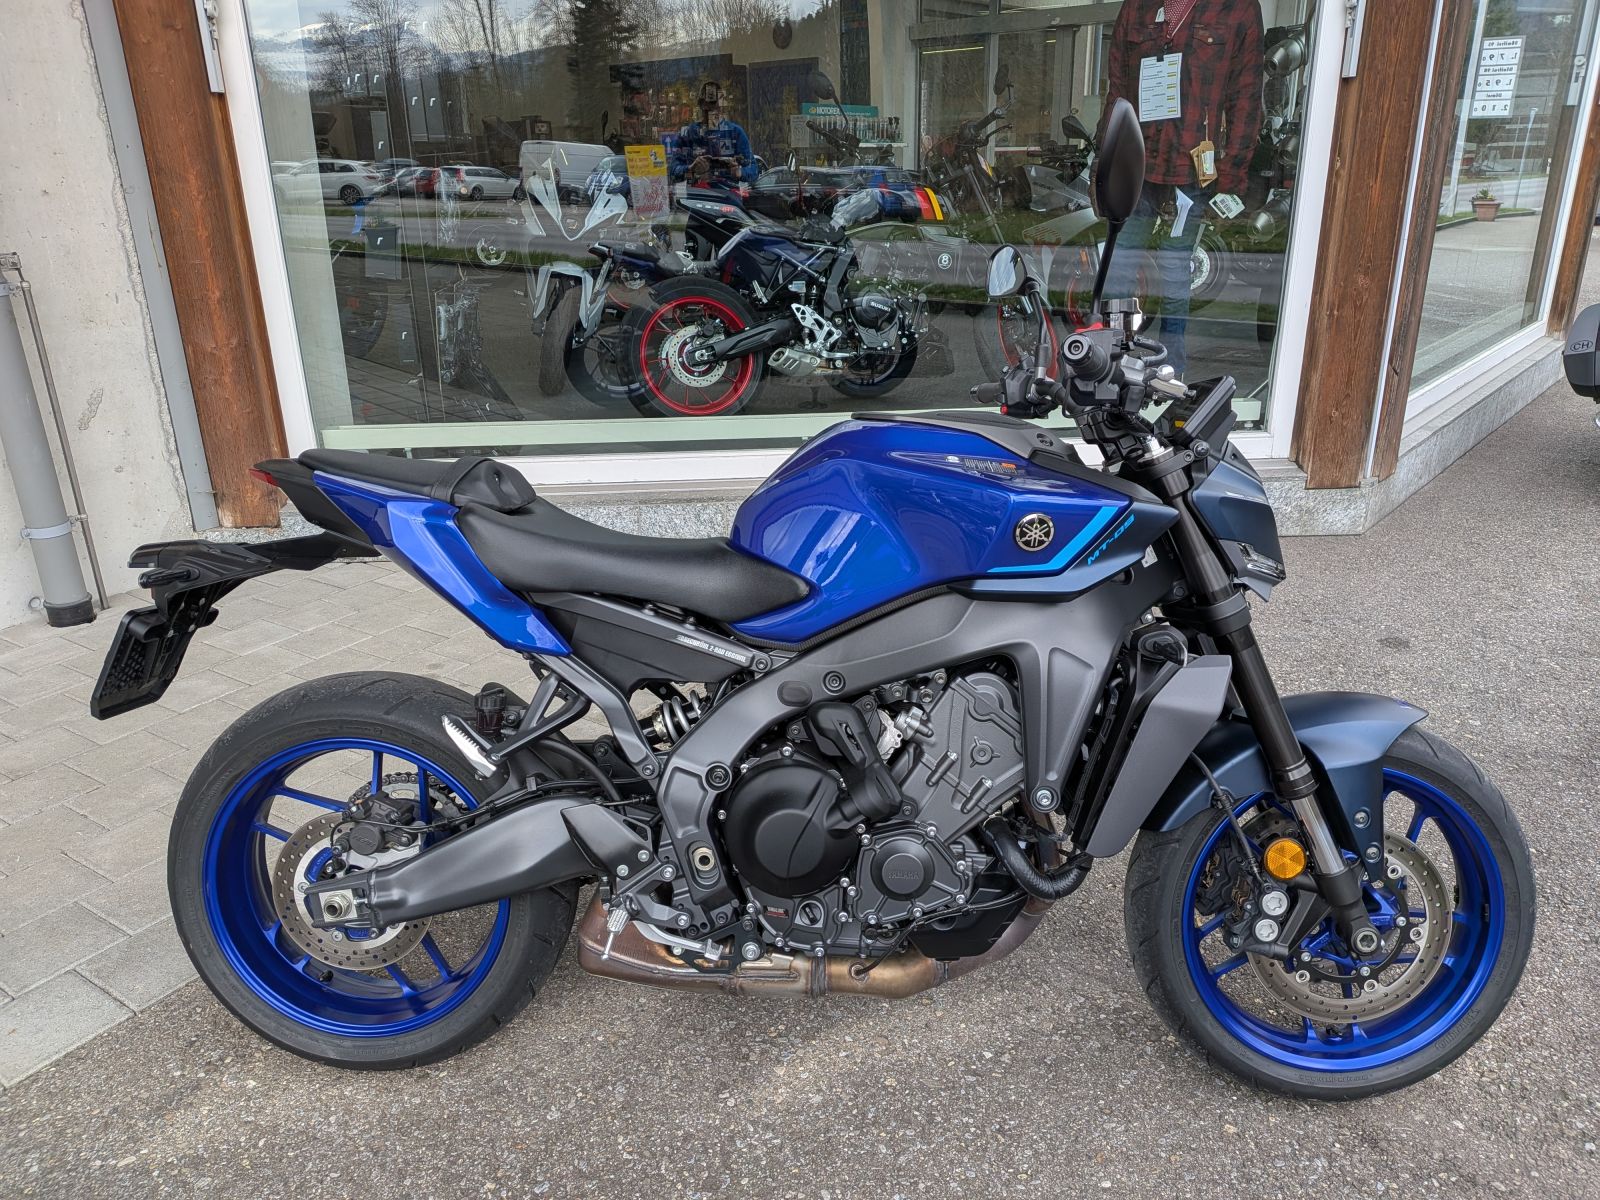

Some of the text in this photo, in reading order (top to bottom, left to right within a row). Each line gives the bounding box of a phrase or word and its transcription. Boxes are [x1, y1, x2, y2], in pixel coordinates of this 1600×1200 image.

[941, 255, 950, 266] 8
[870, 301, 891, 312] SUZUKI
[1573, 341, 1590, 351] CH
[1087, 513, 1135, 566] MT-09
